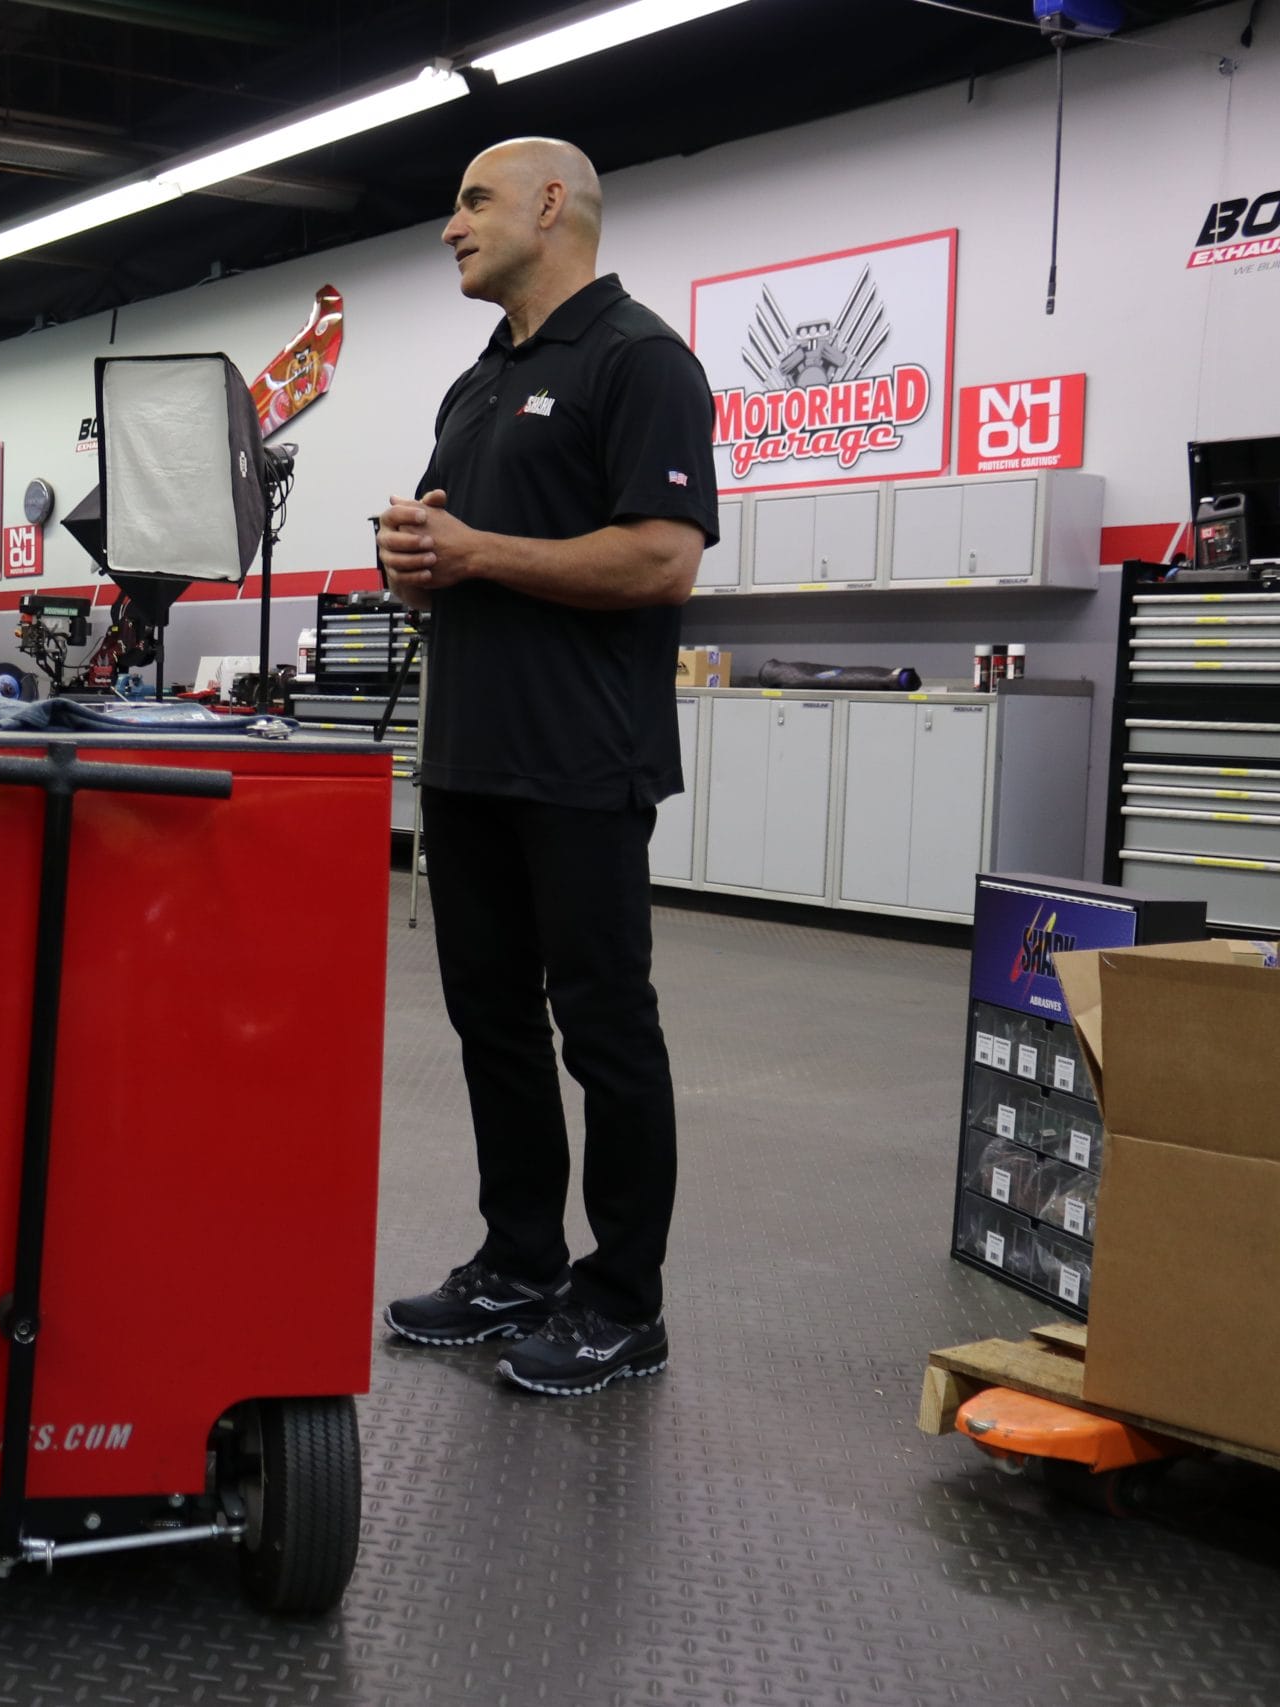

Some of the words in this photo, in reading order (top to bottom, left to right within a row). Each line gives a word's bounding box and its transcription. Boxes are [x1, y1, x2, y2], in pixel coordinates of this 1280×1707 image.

[713, 366, 928, 443] MOTORHEAD
[732, 424, 902, 477] garage
[977, 459, 1020, 472] PROTECTIVE
[1030, 995, 1062, 1012] ABRASIVES
